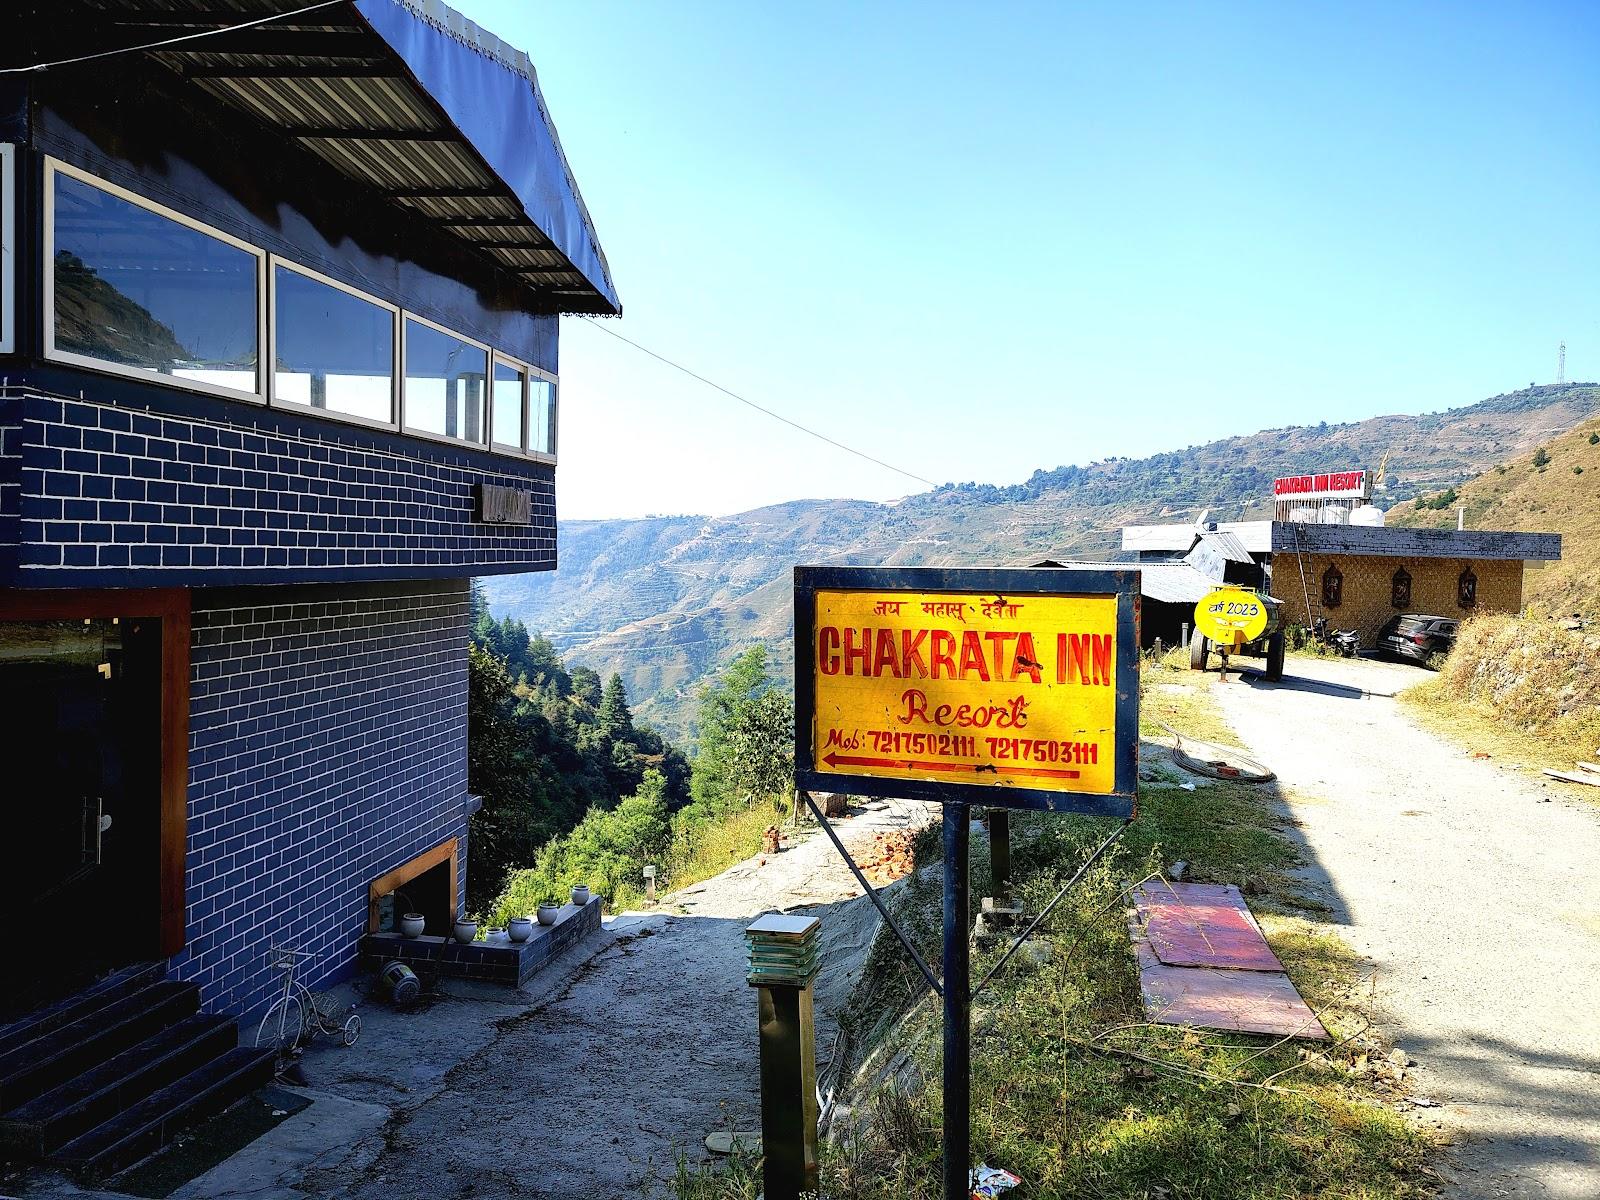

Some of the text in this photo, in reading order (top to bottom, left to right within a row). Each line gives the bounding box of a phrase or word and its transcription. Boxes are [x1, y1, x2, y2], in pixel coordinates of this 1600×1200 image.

[1314, 475, 1329, 492] INN
[1330, 472, 1363, 491] RESORT
[874, 601, 908, 616] जय
[921, 602, 966, 623] महासू
[1227, 602, 1258, 616] 2023
[819, 626, 1112, 687] CHAKRATA INN
[897, 688, 1029, 729] Resort
[985, 737, 1098, 765] 7217503111
